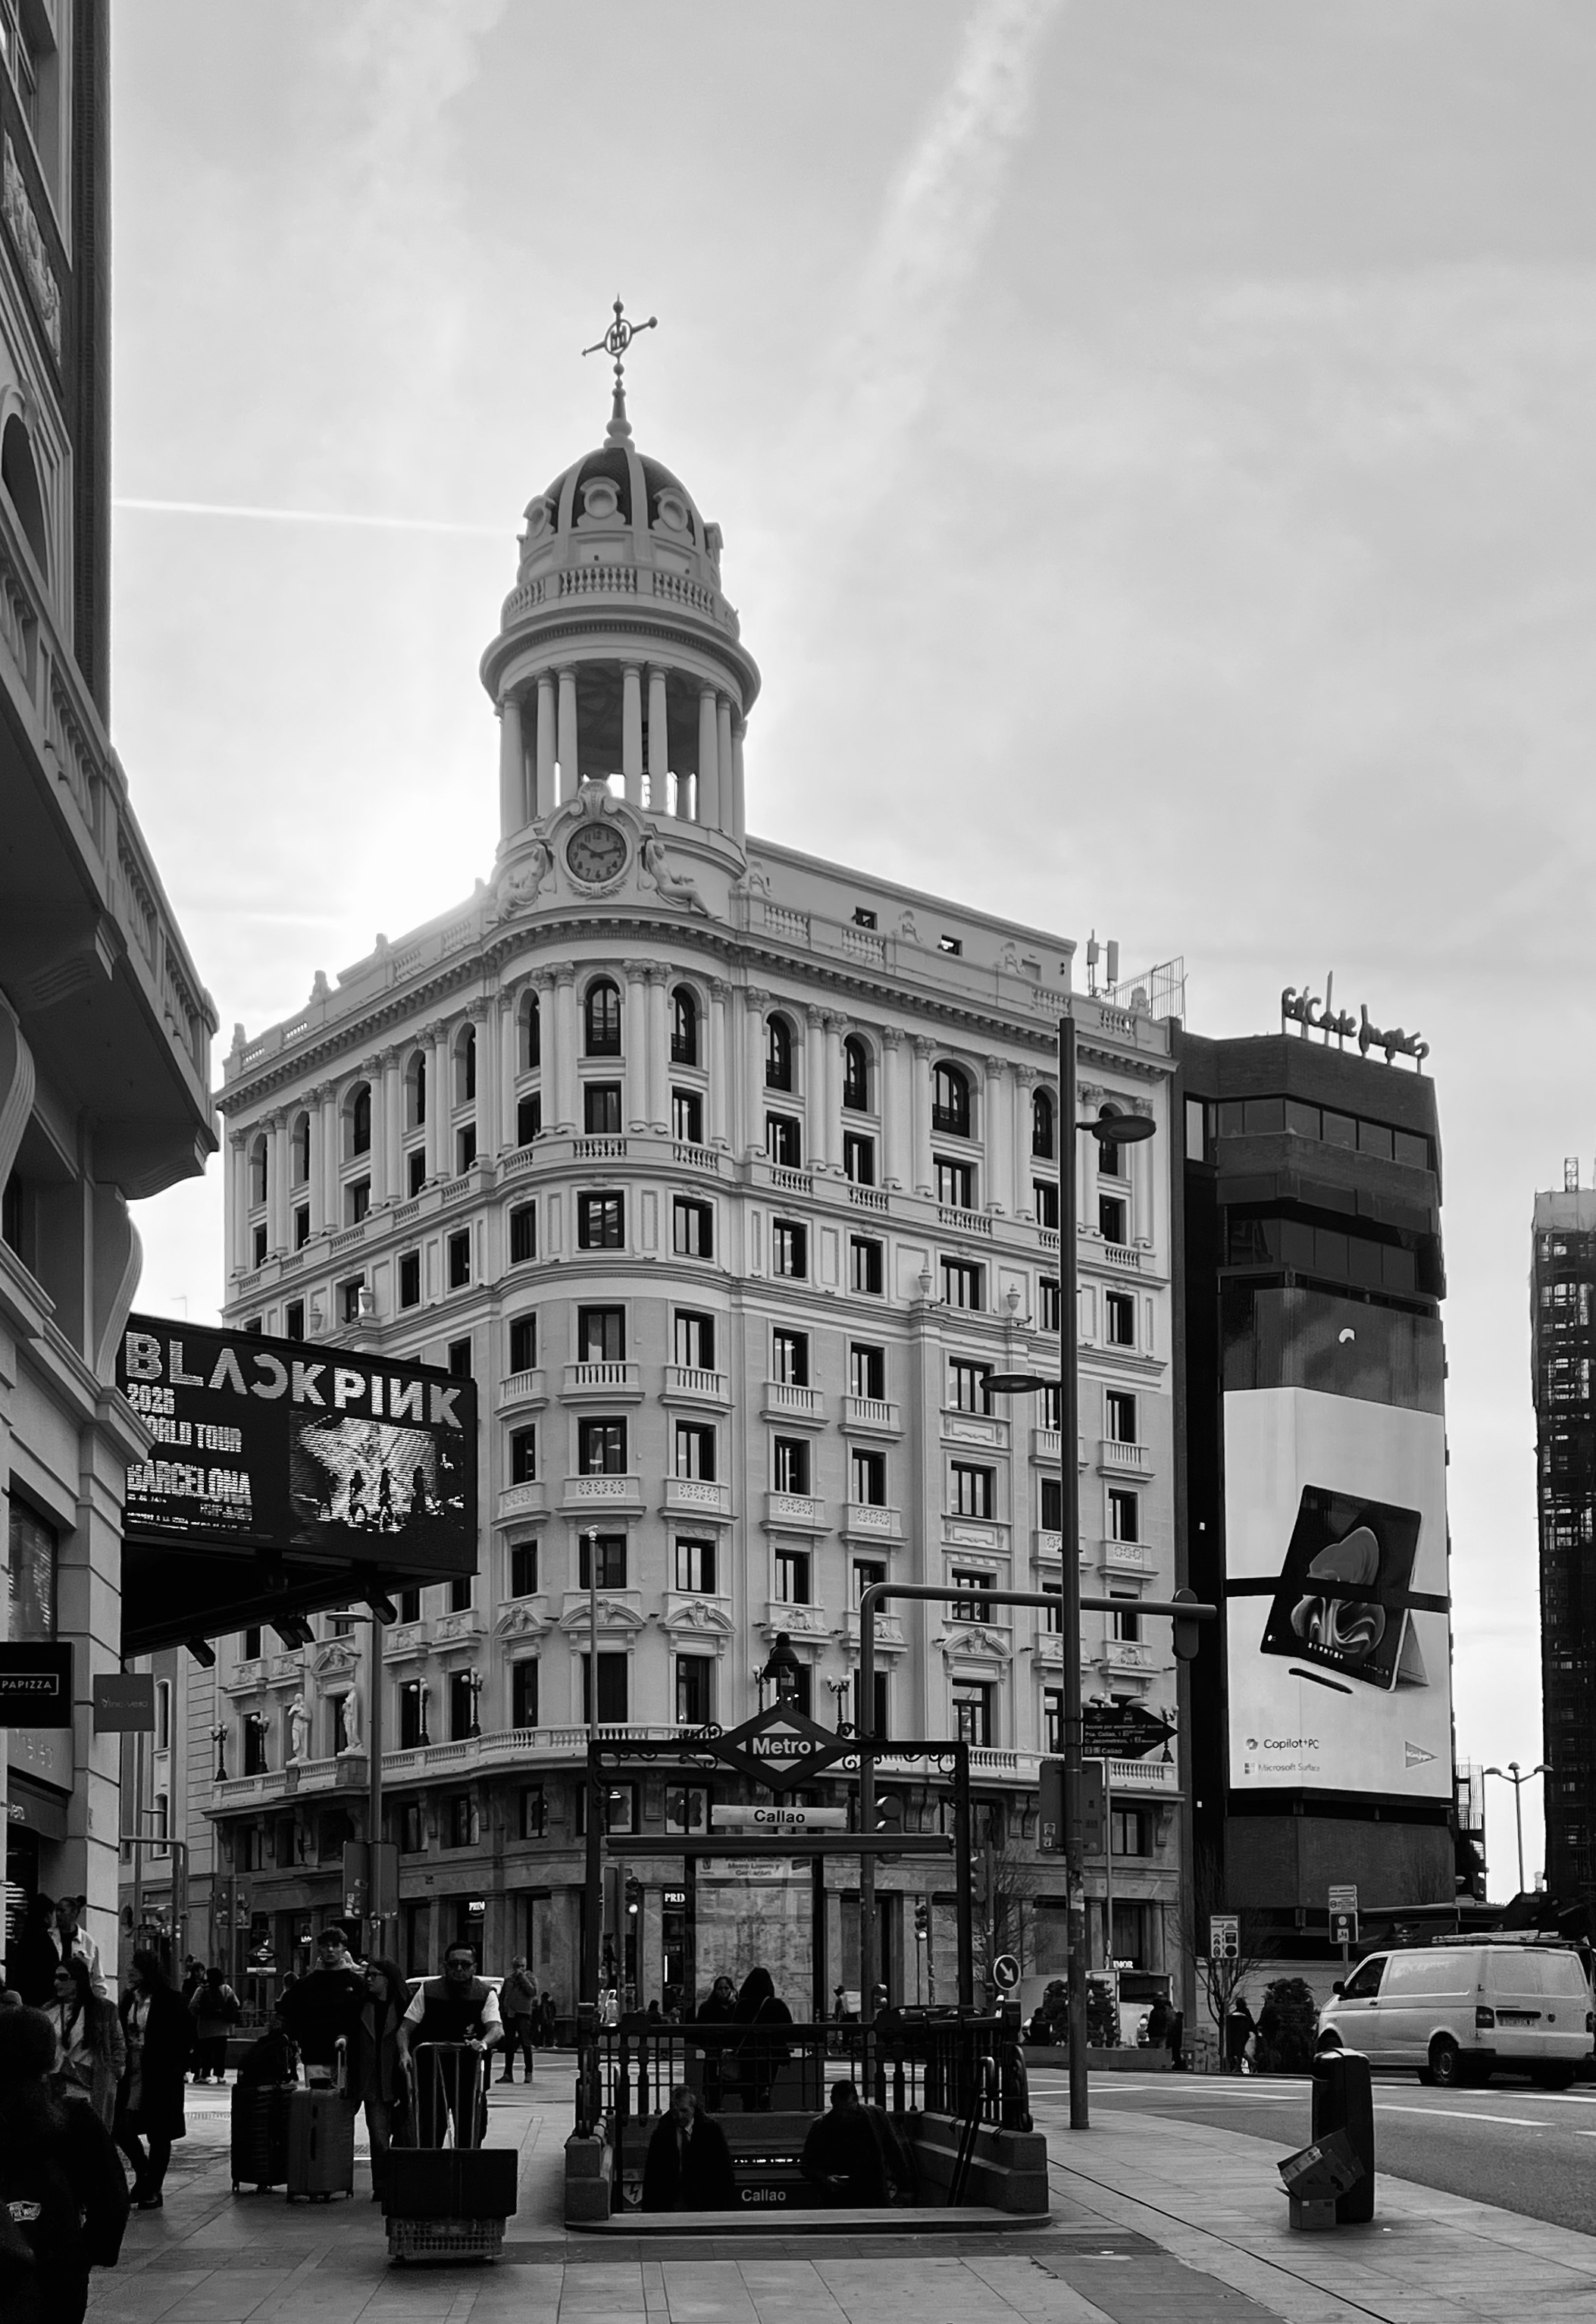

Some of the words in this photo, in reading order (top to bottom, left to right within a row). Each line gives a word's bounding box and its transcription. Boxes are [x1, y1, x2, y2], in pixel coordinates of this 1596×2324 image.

[593, 828, 602, 840] 12
[140, 1414, 192, 1445] ORLD
[194, 1423, 243, 1453] TOUR
[127, 1459, 253, 1506] BARCELONA
[2, 1680, 52, 1690] PAPIZZA
[753, 1737, 812, 1755] Metro
[1258, 1762, 1296, 1772] Microsoft
[1297, 1763, 1321, 1772] Surface
[754, 1809, 806, 1823] Callao
[741, 2188, 787, 2202] Callao
